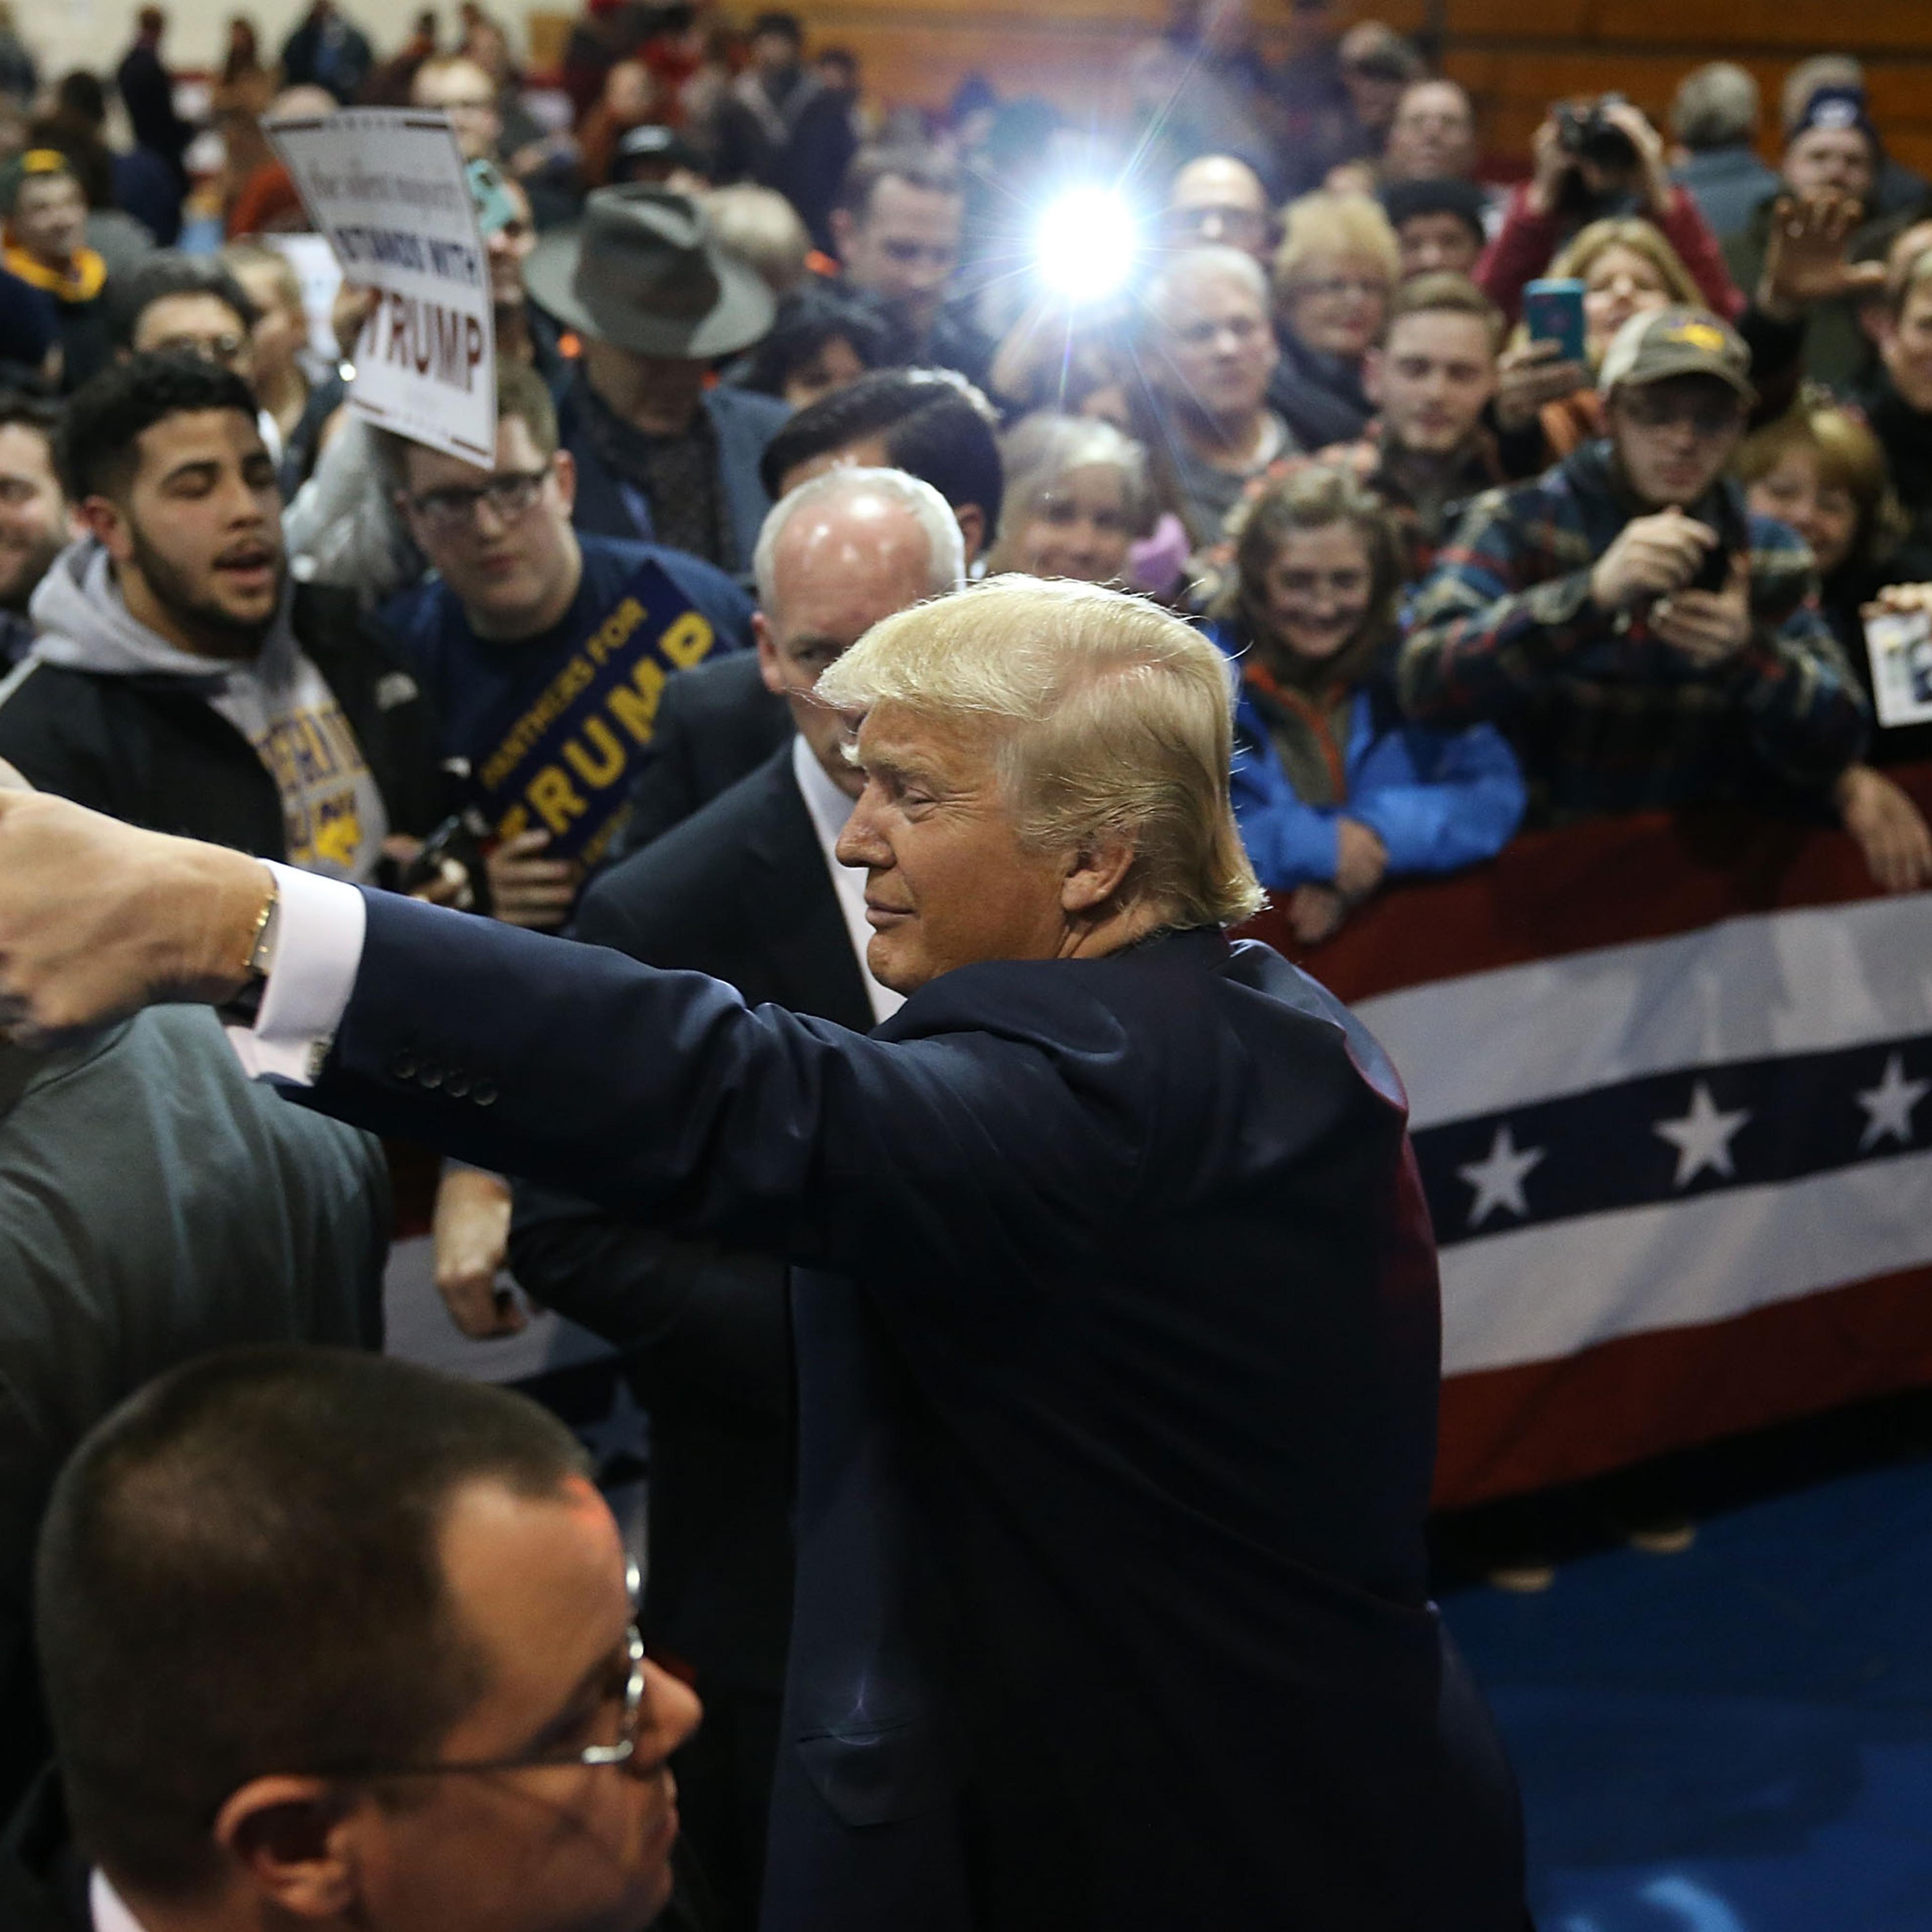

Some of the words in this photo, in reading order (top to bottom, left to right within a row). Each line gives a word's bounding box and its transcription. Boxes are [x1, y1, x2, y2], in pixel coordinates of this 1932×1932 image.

[365, 285, 482, 394] TRUMP
[478, 656, 596, 790] PANTHERS
[586, 597, 648, 664] FOR
